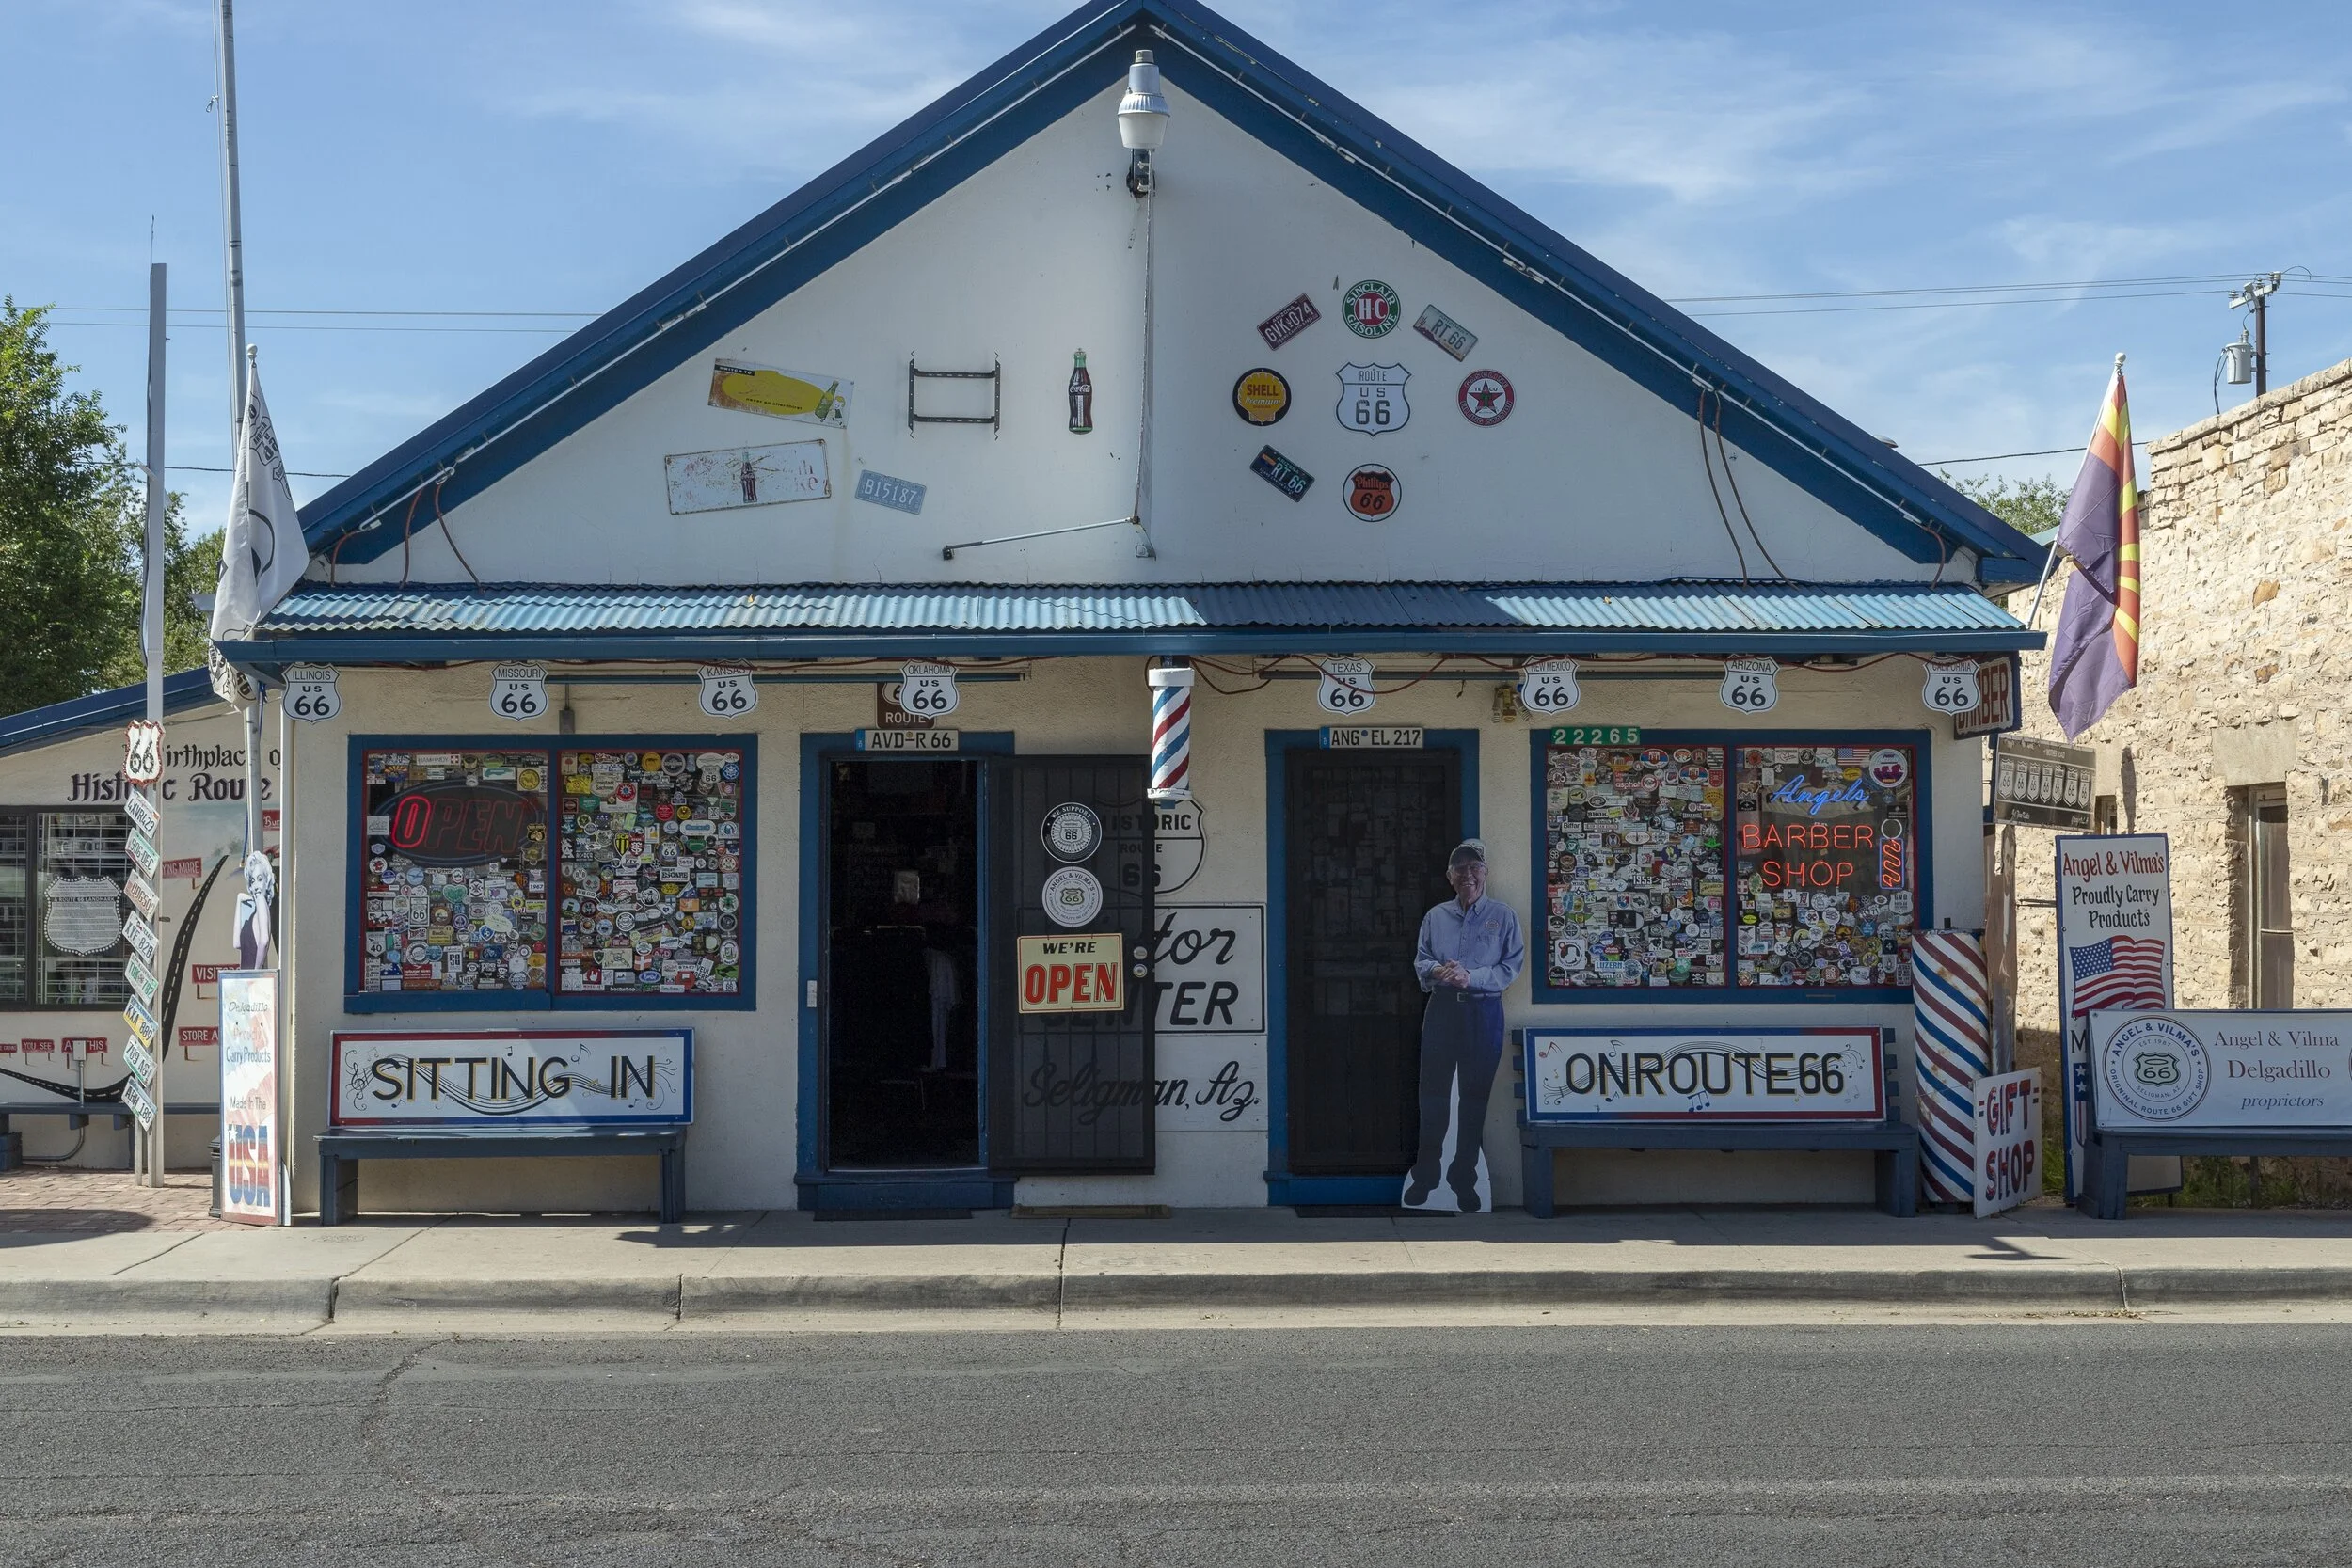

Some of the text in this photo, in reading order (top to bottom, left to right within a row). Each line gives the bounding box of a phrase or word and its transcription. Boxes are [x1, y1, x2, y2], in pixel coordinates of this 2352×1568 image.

[1347, 283, 1395, 306] SINCLAIR
[1264, 302, 1314, 342] GVK 074
[1347, 313, 1396, 337] GASOLINE
[1359, 371, 1387, 382] ROUTE
[1247, 384, 1279, 396] SHELL
[1245, 396, 1281, 405] Premium
[1356, 400, 1391, 425] 66
[865, 478, 918, 506] B15187
[1356, 477, 1390, 491] Phillips
[1360, 492, 1385, 510] 66
[292, 670, 331, 680] ILLINOIS
[498, 668, 541, 679] MISSOURI
[707, 665, 746, 676] KANSAS
[909, 664, 950, 675] OKLAHOMA
[1331, 663, 1362, 673] TEXAS
[1531, 661, 1571, 672] NEW MEXICO
[1731, 660, 1772, 673] ARIZONA
[1932, 661, 1971, 672] CALIFORNIA
[509, 682, 529, 691] US
[718, 679, 737, 688] US
[919, 679, 939, 688] US
[1337, 676, 1357, 685] US
[1541, 676, 1561, 685] US
[1740, 675, 1760, 684] US
[302, 685, 322, 693] US
[1329, 688, 1364, 707] 66
[1534, 687, 1568, 706] 66
[1731, 686, 1766, 706] 66
[1934, 687, 1969, 706] 66
[294, 695, 329, 716] 66
[501, 693, 537, 714] 66
[712, 689, 746, 711] 66
[913, 689, 947, 709] 66
[885, 712, 926, 723] ROUTE
[930, 731, 951, 748] 66
[1331, 729, 1421, 746] ANG EL 217
[130, 739, 154, 774] 66
[162, 744, 246, 771] irthplac
[188, 772, 272, 802] Roue
[1770, 774, 1869, 815] Angels
[1050, 806, 1091, 819] WE SUPPORT
[391, 795, 524, 853] OPEN
[1065, 832, 1077, 840] 66
[1742, 823, 1874, 849] BARBER
[179, 861, 199, 874] MORE
[1762, 860, 1853, 887] SHOP
[2063, 849, 2166, 883] Angel & Vilma's
[1050, 875, 1067, 891] ANGEL
[1074, 873, 1095, 891] VILMA'S
[2073, 884, 2160, 909] Proudly Carry
[413, 910, 425, 920] 66
[2089, 909, 2151, 929] Products
[1043, 942, 1097, 955] WE'RE
[1025, 961, 1118, 1005] OPEN
[229, 1002, 268, 1015] Delgadillo
[182, 1030, 207, 1041] STORE
[2112, 1026, 2143, 1057] ANGEL
[2145, 1023, 2153, 1032] &
[2158, 1023, 2200, 1057] VILMA'S
[2215, 1030, 2340, 1050] Angel & Vilma
[226, 1047, 271, 1065] Carry Products
[372, 1055, 656, 1101] SITTING IN
[2144, 1067, 2170, 1079] 66
[2227, 1059, 2331, 1083] Delgadillo
[1195, 1060, 1261, 1123] Az.
[2141, 1106, 2169, 1115] ROUTE
[2171, 1105, 2182, 1114] 66
[2183, 1091, 2198, 1107] GIFT
[2196, 1069, 2204, 1090] SHOP
[2173, 1085, 2181, 1094] AZ
[230, 1096, 246, 1110] Made
[255, 1096, 267, 1110] The
[2241, 1093, 2325, 1110] proprietors
[228, 1124, 270, 1208] USA
[1985, 1139, 2035, 1201] SHOP
